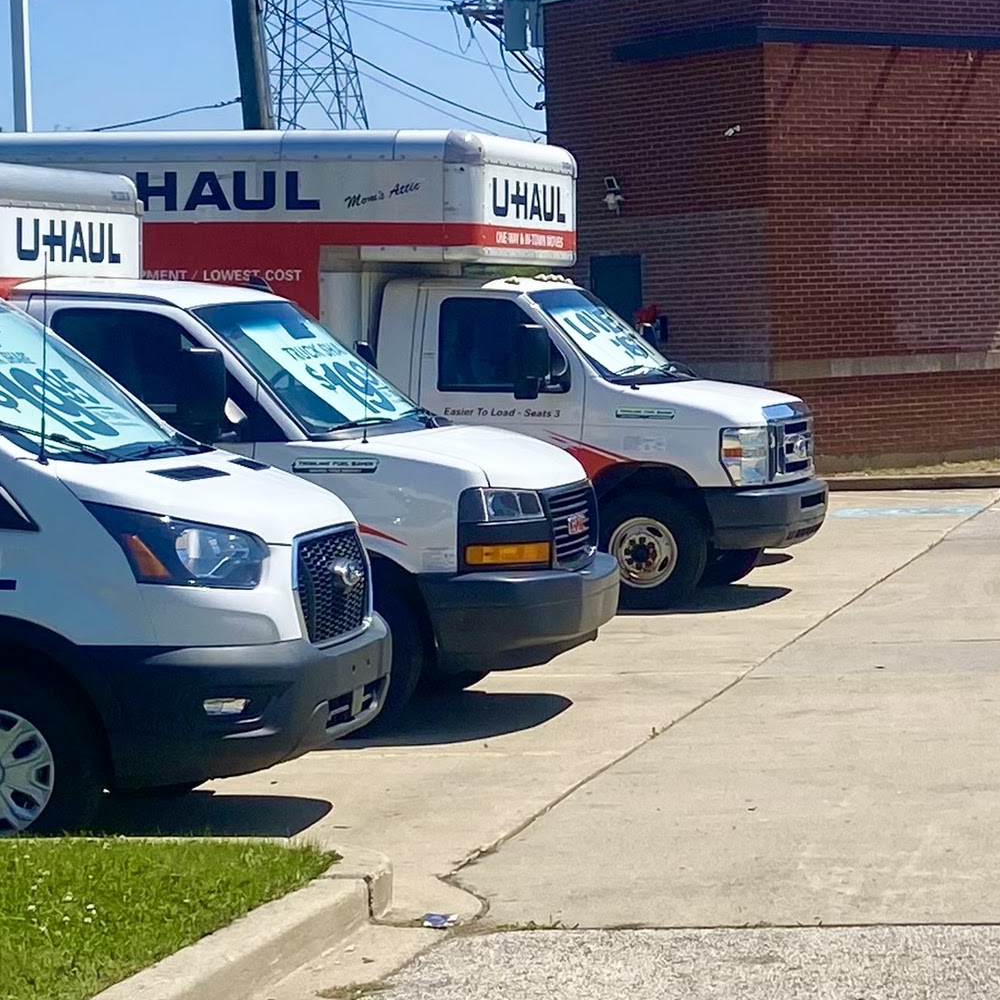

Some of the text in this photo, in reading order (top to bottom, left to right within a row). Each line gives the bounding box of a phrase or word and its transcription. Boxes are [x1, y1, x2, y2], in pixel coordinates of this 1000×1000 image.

[344, 182, 421, 208] Mom's Attic
[492, 177, 566, 223] U-HAUL
[16, 217, 121, 264] U-HAUL
[265, 269, 302, 281] COST
[443, 407, 474, 416] Easier
[477, 407, 489, 417] To
[491, 408, 516, 417] Load
[524, 408, 552, 418] Seats
[554, 409, 561, 418] 3
